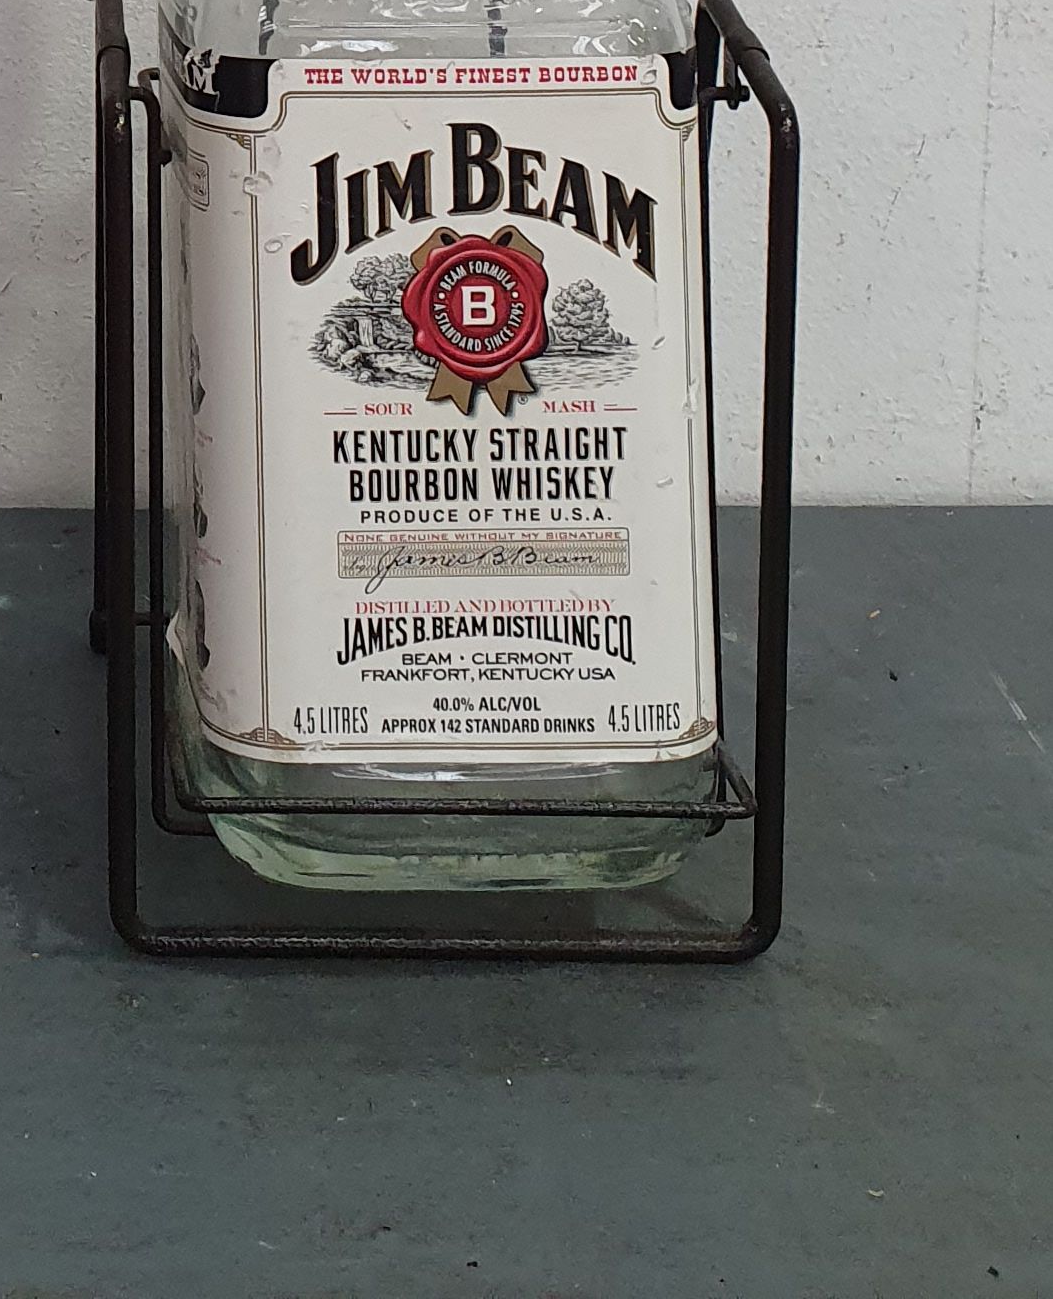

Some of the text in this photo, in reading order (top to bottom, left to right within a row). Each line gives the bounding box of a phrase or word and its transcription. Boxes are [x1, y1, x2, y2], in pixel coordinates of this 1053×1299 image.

[304, 65, 638, 85] THE WORLD'S FINEST BOURBON
[290, 122, 658, 287] JIM BEAM
[439, 260, 517, 292] BEAM FORMULA
[460, 285, 497, 326] B
[434, 312, 482, 352] STANDARD
[484, 326, 514, 351] SINCE
[507, 302, 524, 328] 1795
[364, 400, 596, 416] SOUR MASH
[333, 426, 627, 464] KENTUCKY STRAIGHT
[349, 466, 615, 502] BOURBON WHISKEY
[360, 507, 613, 524] PRODUCE OF THE U.S.A.
[344, 531, 622, 543] NONE GENUINE WITHOUT MY SIGNATURE
[355, 598, 614, 615] DISTILLED AND BOTTLED BY
[337, 616, 408, 666] JAMES
[495, 615, 600, 651] DISTILLING
[605, 615, 637, 666] CO.
[402, 652, 573, 666] BEAM CLERMONT
[361, 668, 616, 683] FRANKFORT, KENTUCKY USA
[432, 696, 541, 712] 40.0% ALC/VOL
[293, 706, 369, 735] 4.5 LITRES
[381, 717, 595, 734] APPROX 142 STANDARD DRINKS
[608, 703, 680, 733] 4.5 LITRES
